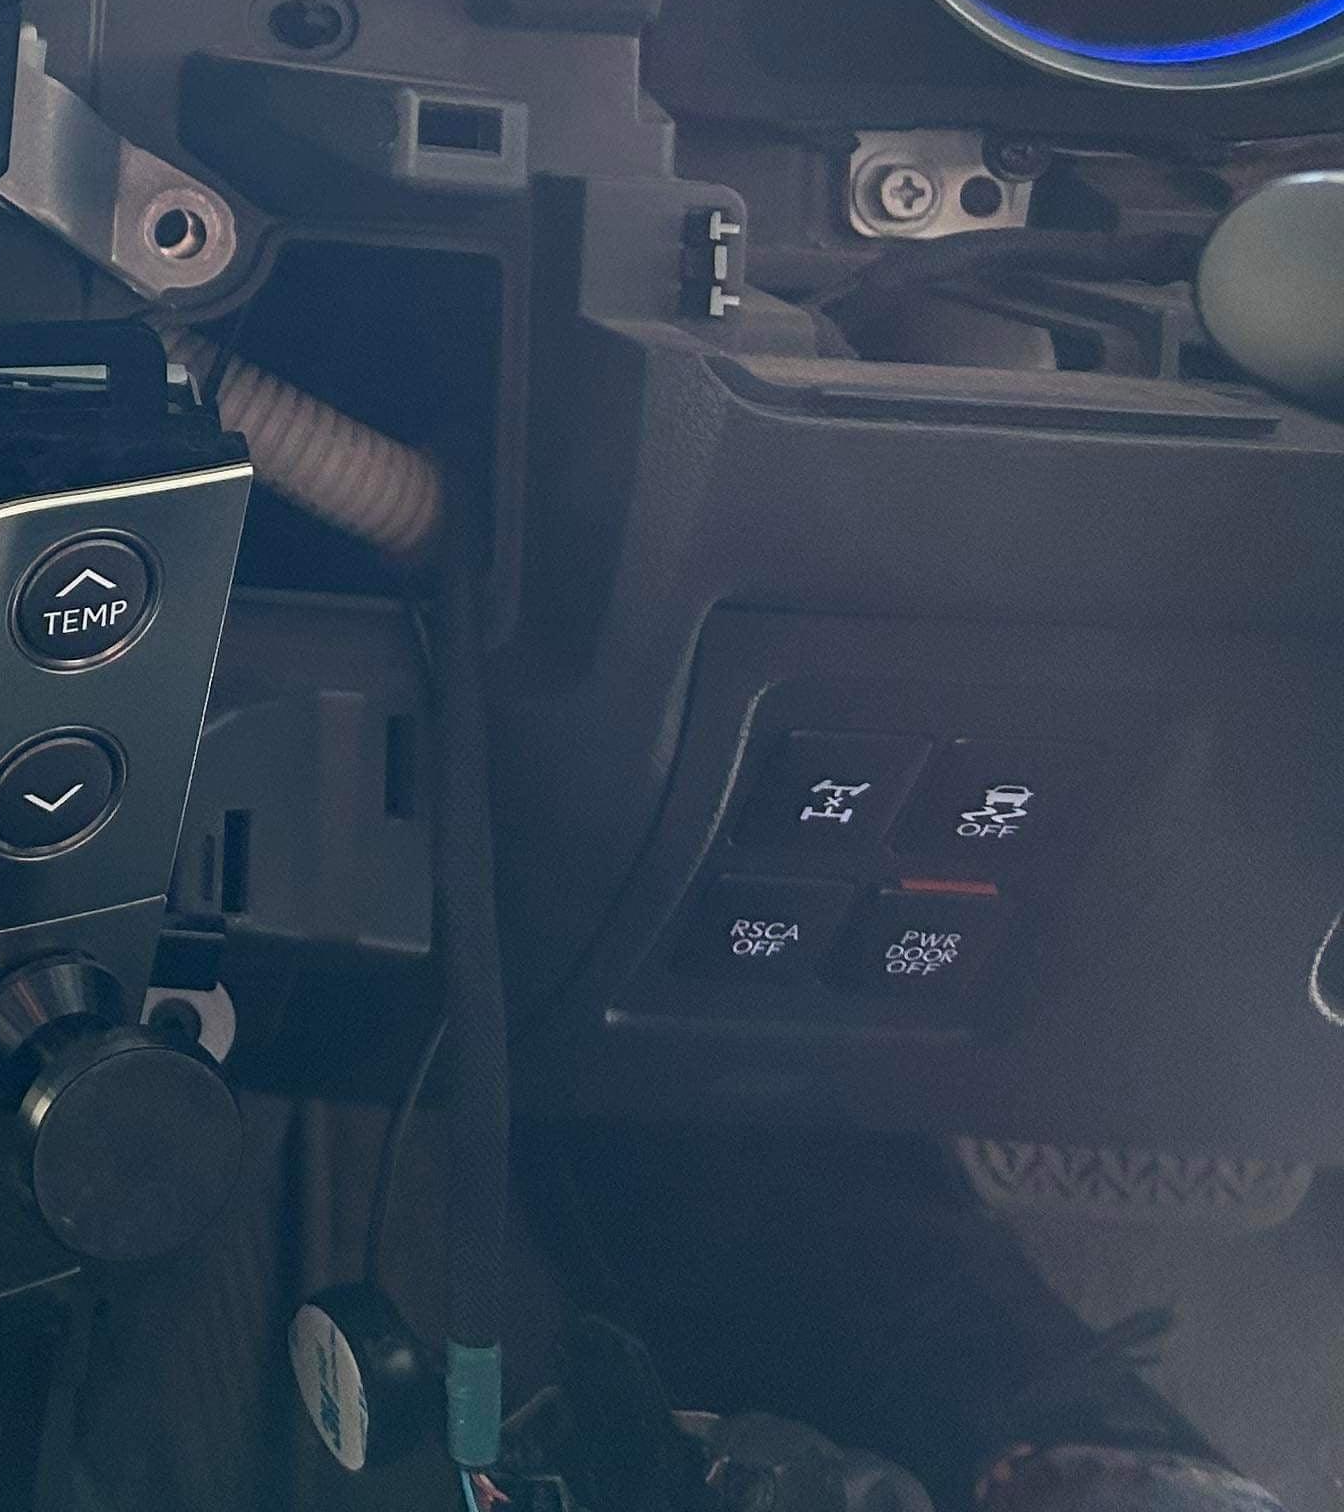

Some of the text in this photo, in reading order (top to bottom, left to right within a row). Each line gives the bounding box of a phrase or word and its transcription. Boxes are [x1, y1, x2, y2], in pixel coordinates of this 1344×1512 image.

[43, 600, 127, 635] TEMP
[956, 823, 1020, 839] OFF
[730, 919, 799, 940] RSCA
[732, 940, 785, 957] OFF
[900, 931, 961, 949] PWR
[885, 945, 958, 964] DOOR
[885, 960, 941, 976] OFF
